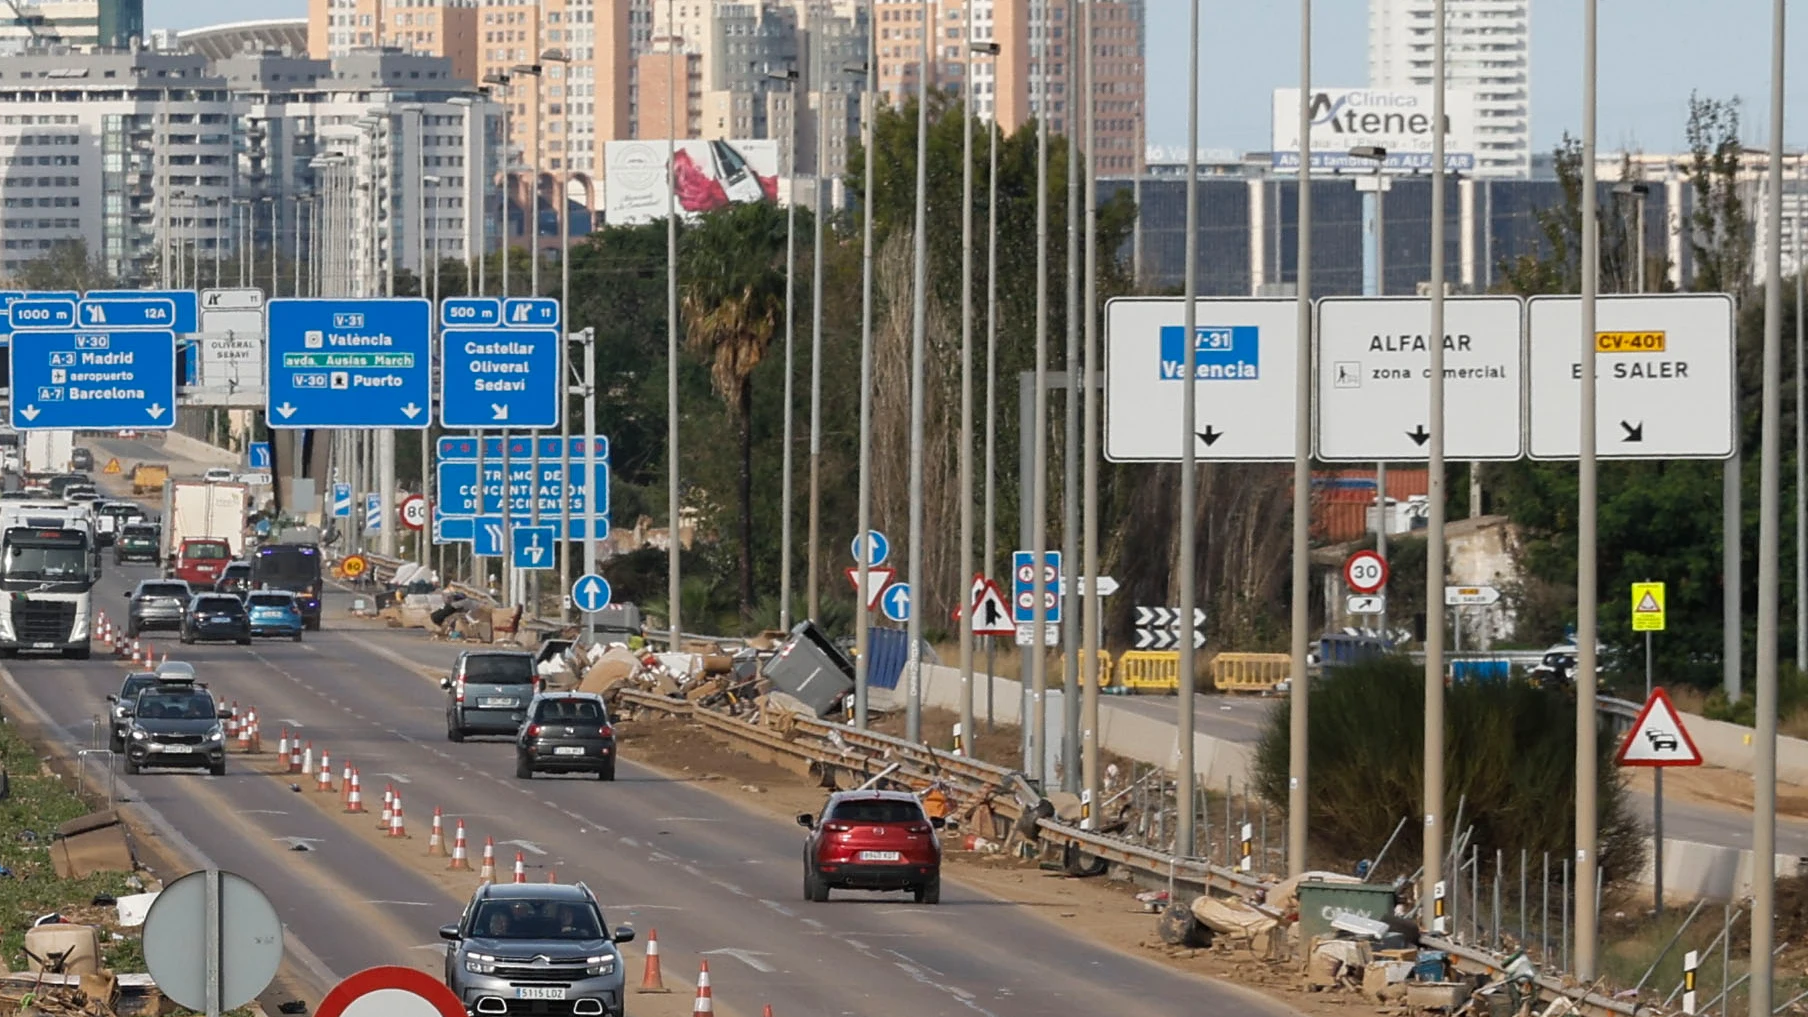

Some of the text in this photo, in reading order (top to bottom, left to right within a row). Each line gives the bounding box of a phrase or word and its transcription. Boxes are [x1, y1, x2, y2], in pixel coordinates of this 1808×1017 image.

[18, 310, 50, 320] 1000
[143, 308, 167, 319] 12A
[450, 307, 493, 318] 500 m
[541, 307, 552, 318] 11
[336, 315, 363, 327] V-31
[77, 336, 108, 347] V-30
[328, 331, 393, 346] València
[1368, 335, 1471, 352] ALFAAR
[1597, 335, 1664, 349] CV-401
[464, 341, 535, 355] Castellar
[51, 352, 134, 365] A-3 Madrid
[373, 354, 412, 367] March
[469, 361, 530, 373] Oliveral
[1162, 360, 1256, 378] Vaencia
[1372, 365, 1507, 380] zona cmercial
[1571, 362, 1689, 379] E SALER
[70, 372, 135, 383] aeropuerto
[293, 375, 403, 387] V-30 Puerto
[40, 387, 145, 400] A-7 Barcelona
[483, 470, 533, 481] TRMO
[1353, 564, 1378, 580] 30
[519, 988, 542, 999] 5115
